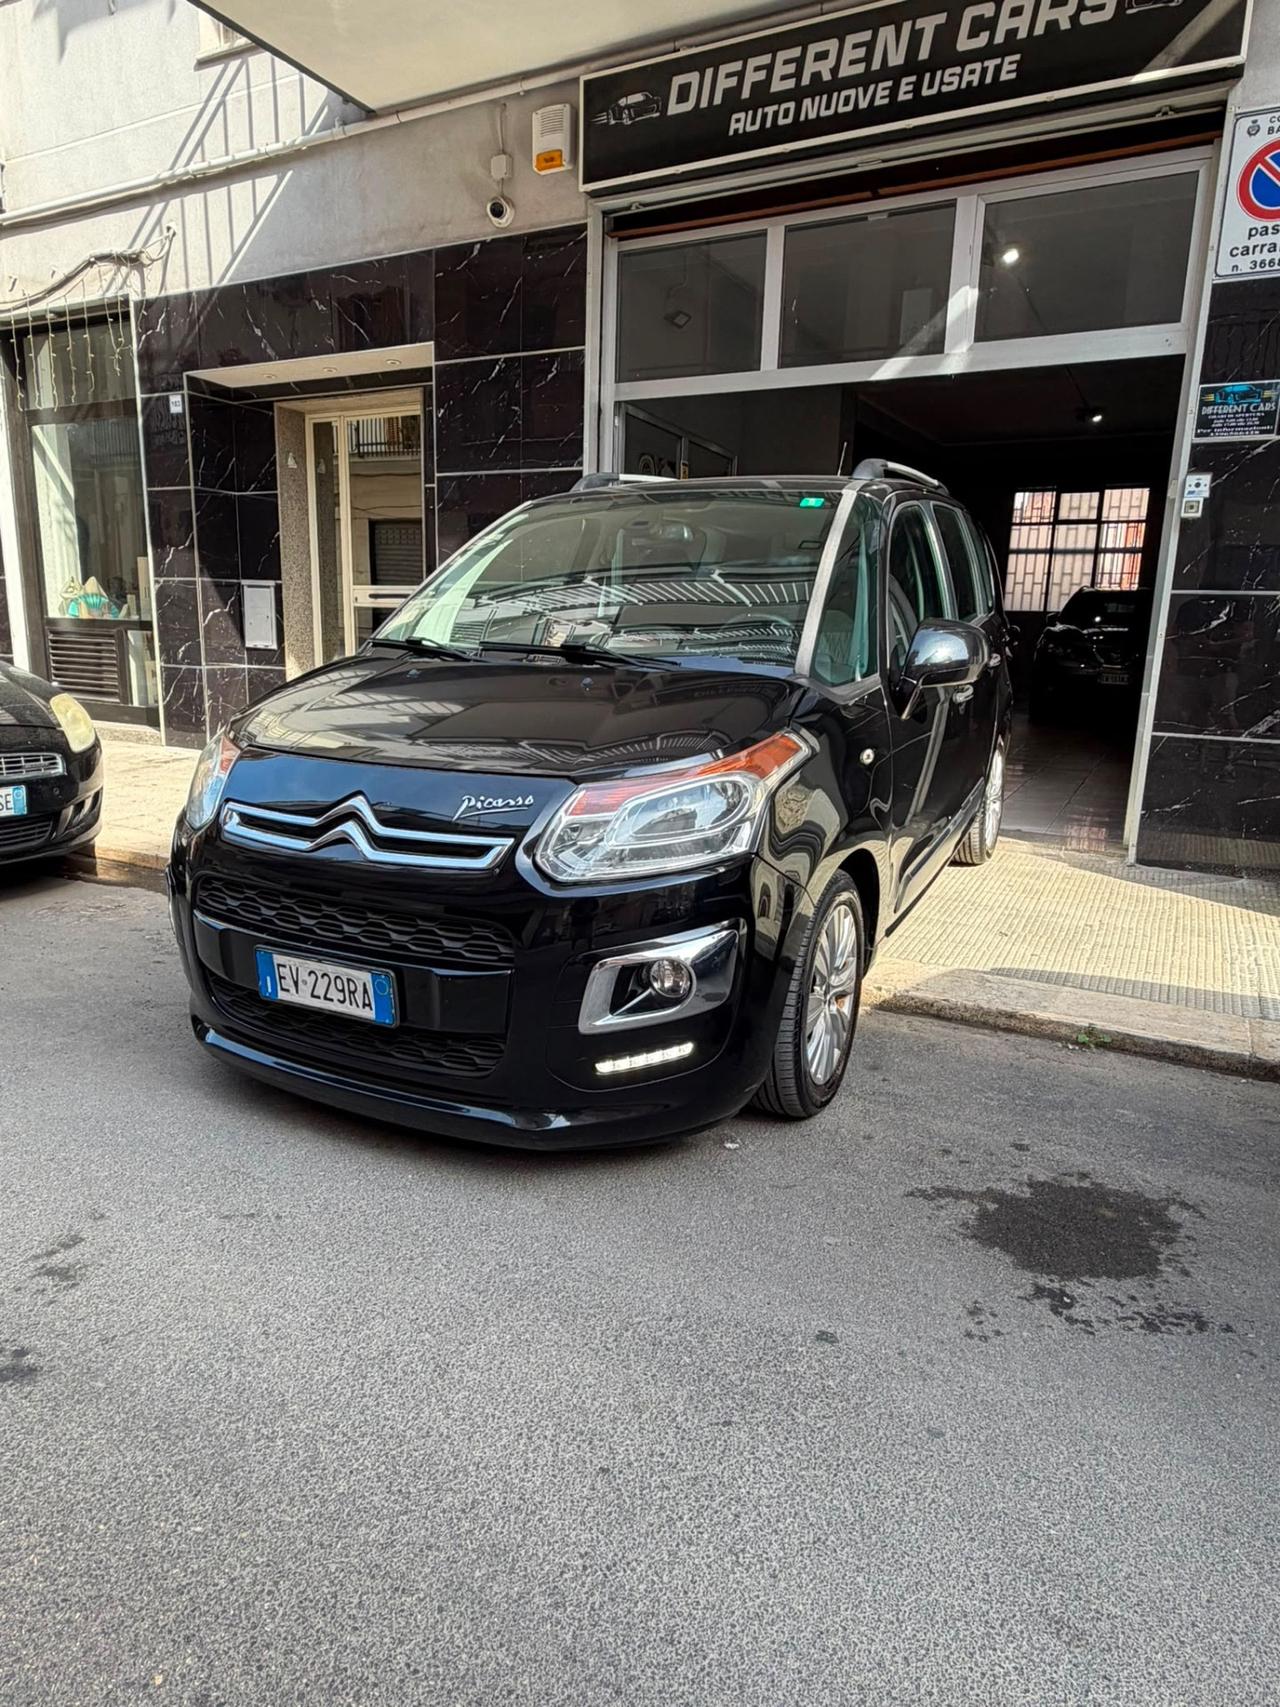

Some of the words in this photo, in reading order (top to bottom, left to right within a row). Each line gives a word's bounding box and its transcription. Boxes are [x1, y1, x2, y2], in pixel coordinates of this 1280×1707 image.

[667, 11, 947, 116] DIFFERENT
[955, 0, 1118, 52] CARS
[728, 100, 796, 137] AUTO
[800, 80, 893, 122] NUOVE
[897, 75, 917, 102] E
[921, 53, 1022, 97] USATE
[1229, 242, 1280, 258] carra
[452, 795, 535, 822] Picasso
